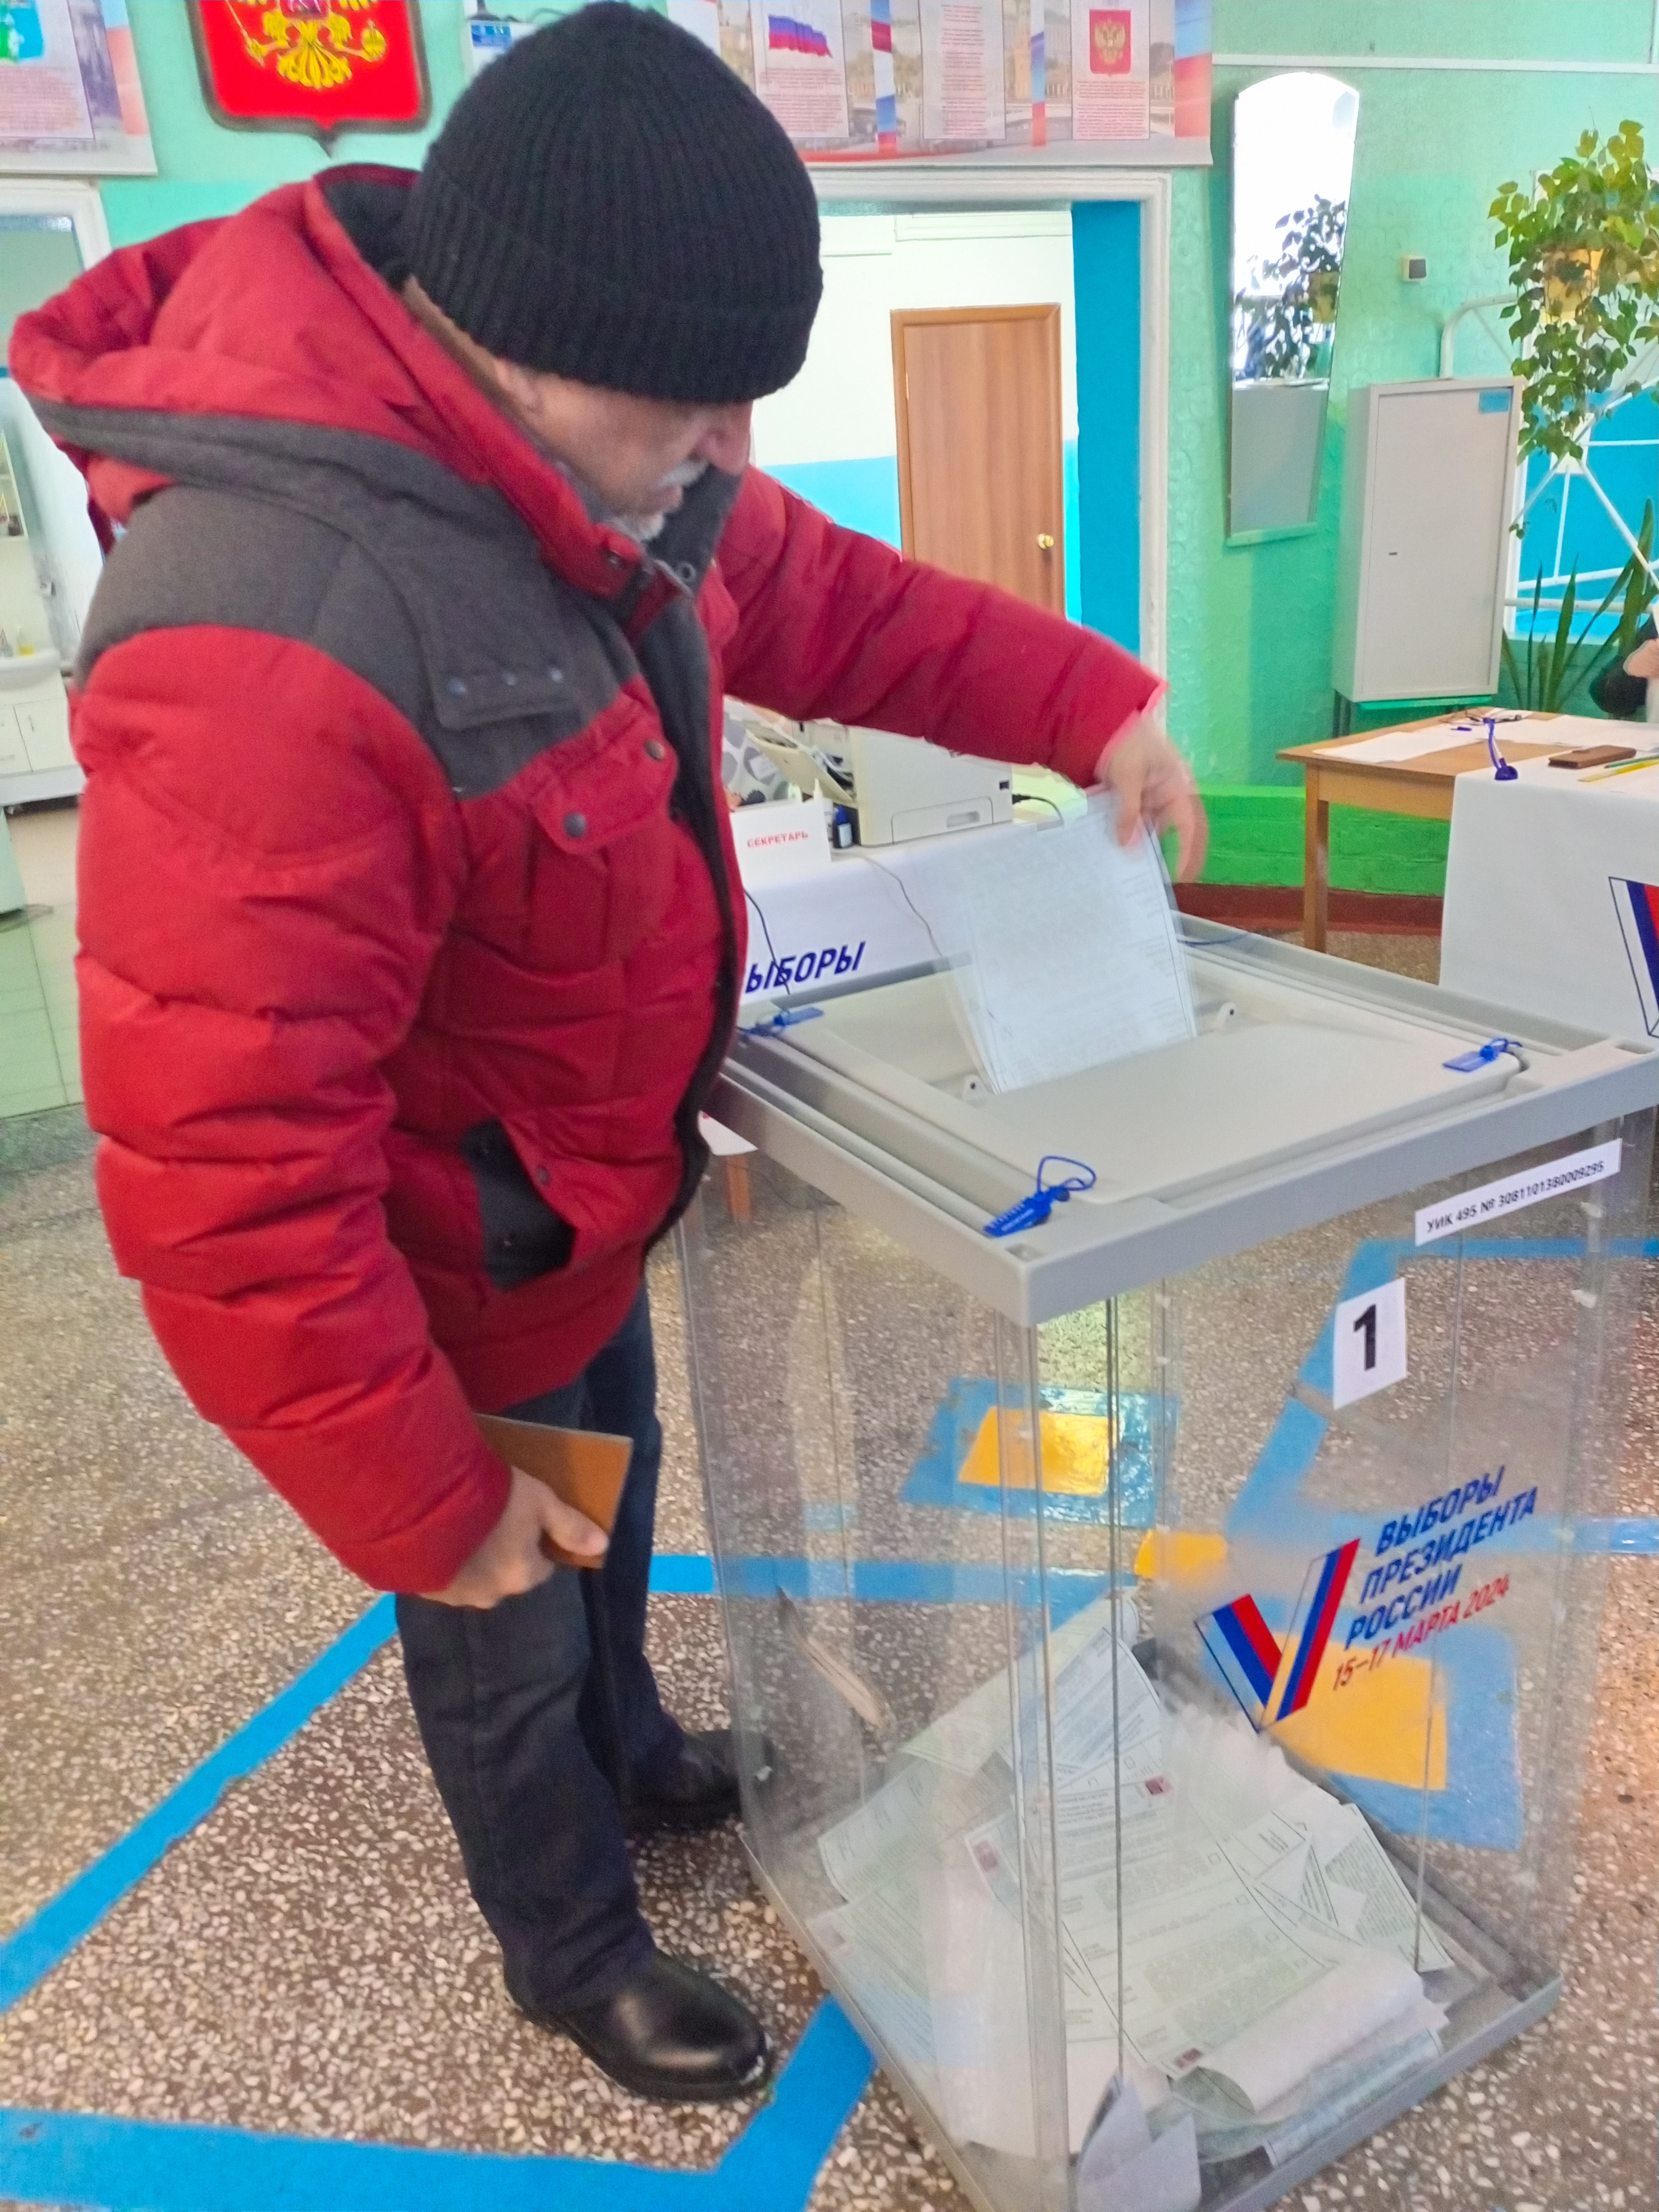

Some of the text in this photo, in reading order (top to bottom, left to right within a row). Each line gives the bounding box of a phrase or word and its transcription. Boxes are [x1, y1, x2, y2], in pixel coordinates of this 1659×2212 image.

[747, 830, 808, 848] СЕКРЕТАРЬ
[745, 940, 866, 993] ЫБОРЫ
[1427, 1212, 1453, 1233] УИК
[1456, 1204, 1477, 1220] 495
[1481, 1198, 1496, 1214] №
[1353, 1303, 1376, 1371] 1
[1360, 1486, 1537, 1604] ПРЕЗИДЕНТА
[1375, 1464, 1505, 1556] ВЫБОРЫ
[1344, 1563, 1463, 1651] РОССИИ
[1392, 1600, 1461, 1659] МАРТА
[1462, 1574, 1509, 1619] 2024
